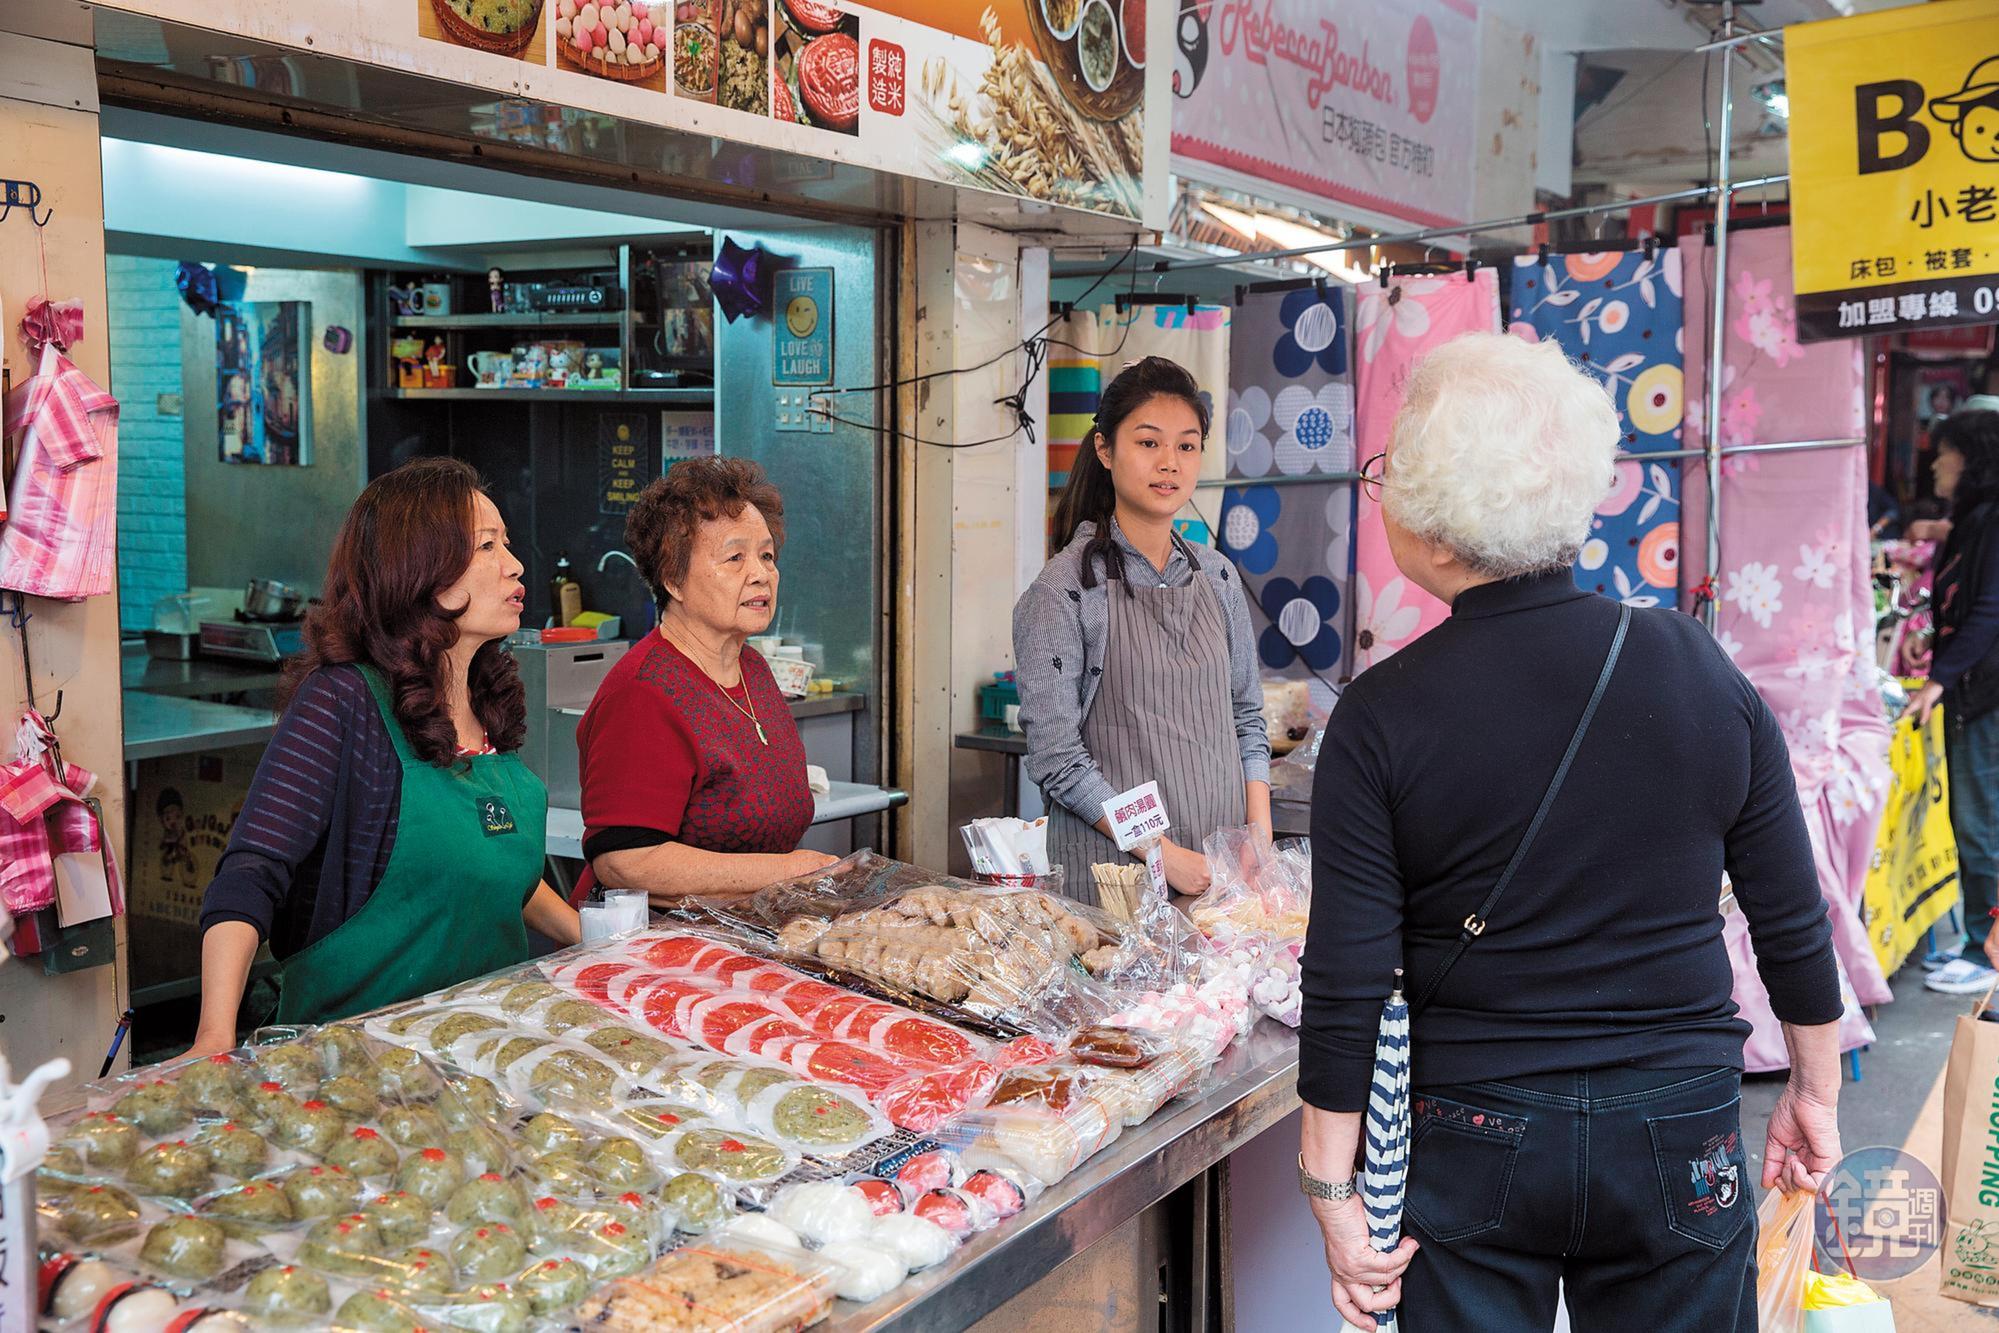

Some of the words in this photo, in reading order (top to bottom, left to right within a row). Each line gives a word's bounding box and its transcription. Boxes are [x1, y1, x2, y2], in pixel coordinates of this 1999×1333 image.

[872, 46, 887, 106] 製造
[887, 50, 903, 109] 純米
[1855, 79, 1931, 176] B
[790, 276, 814, 292] LIVE
[1838, 290, 1959, 329] 加盟專線
[1973, 287, 1999, 315] 0
[781, 340, 808, 356] LOVE
[782, 359, 821, 375] LAUGH
[612, 445, 635, 455] KEEP
[612, 459, 636, 469] CALM
[612, 480, 635, 489] KEEP
[1125, 814, 1164, 838] 一盒110元
[1978, 1075, 1999, 1209] PPING
